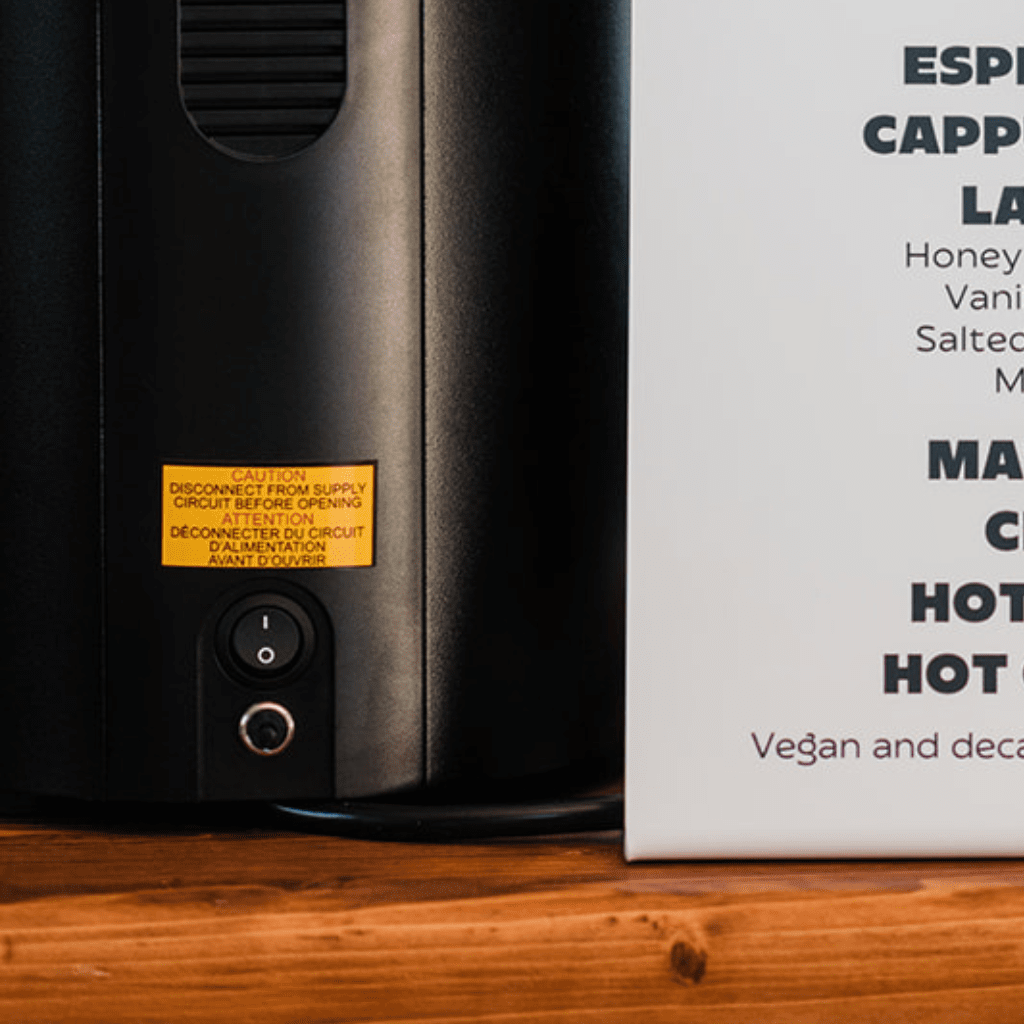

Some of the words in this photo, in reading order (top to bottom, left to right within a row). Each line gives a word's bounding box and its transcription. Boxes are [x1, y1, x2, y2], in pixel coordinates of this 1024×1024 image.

[905, 241, 1022, 276] Honey
[231, 469, 306, 483] CAUTION
[170, 482, 263, 495] DISCONNECT
[267, 483, 309, 496] FROM
[313, 482, 367, 496] SUPPLY
[173, 496, 230, 510] CIRCUIT
[234, 497, 294, 510] BEFORE
[297, 496, 362, 510] OPENING
[221, 512, 315, 526] ATTENTION
[170, 524, 280, 539] DÉCONNECTER
[283, 527, 305, 539] DU
[308, 525, 365, 539] CIRCUIT
[208, 554, 254, 566] AVANT
[883, 653, 1009, 695] HOT
[751, 732, 861, 767] Vegan
[872, 732, 939, 760] and
